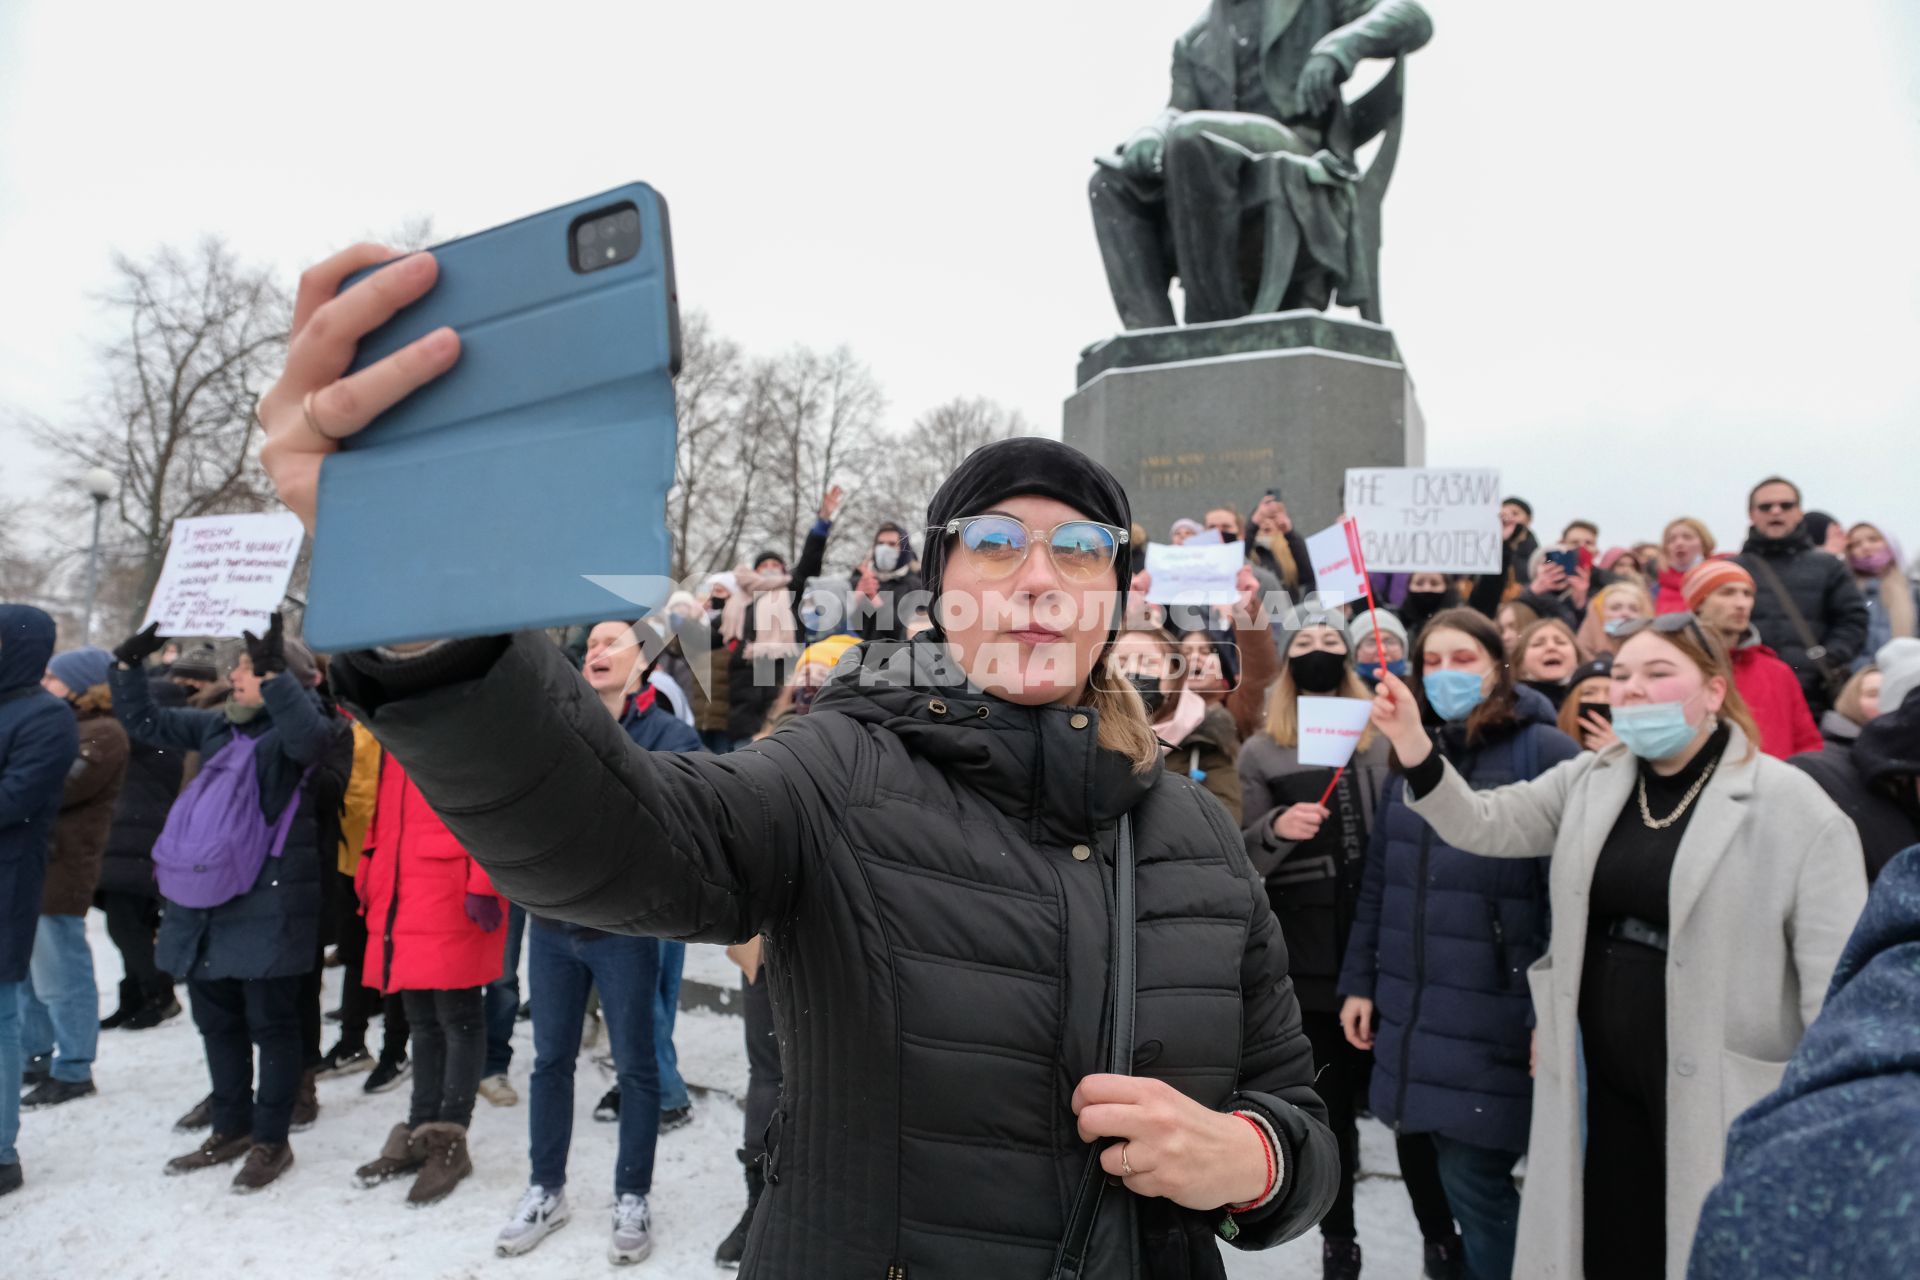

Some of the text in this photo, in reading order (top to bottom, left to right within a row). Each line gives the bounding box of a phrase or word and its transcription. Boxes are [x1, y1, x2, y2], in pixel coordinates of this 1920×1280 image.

[1351, 473, 1500, 506] МНЕ СКАЗАЛИ
[1401, 508, 1443, 526] ТУТ
[1361, 530, 1500, 567] ВАДИСКОТЕКА
